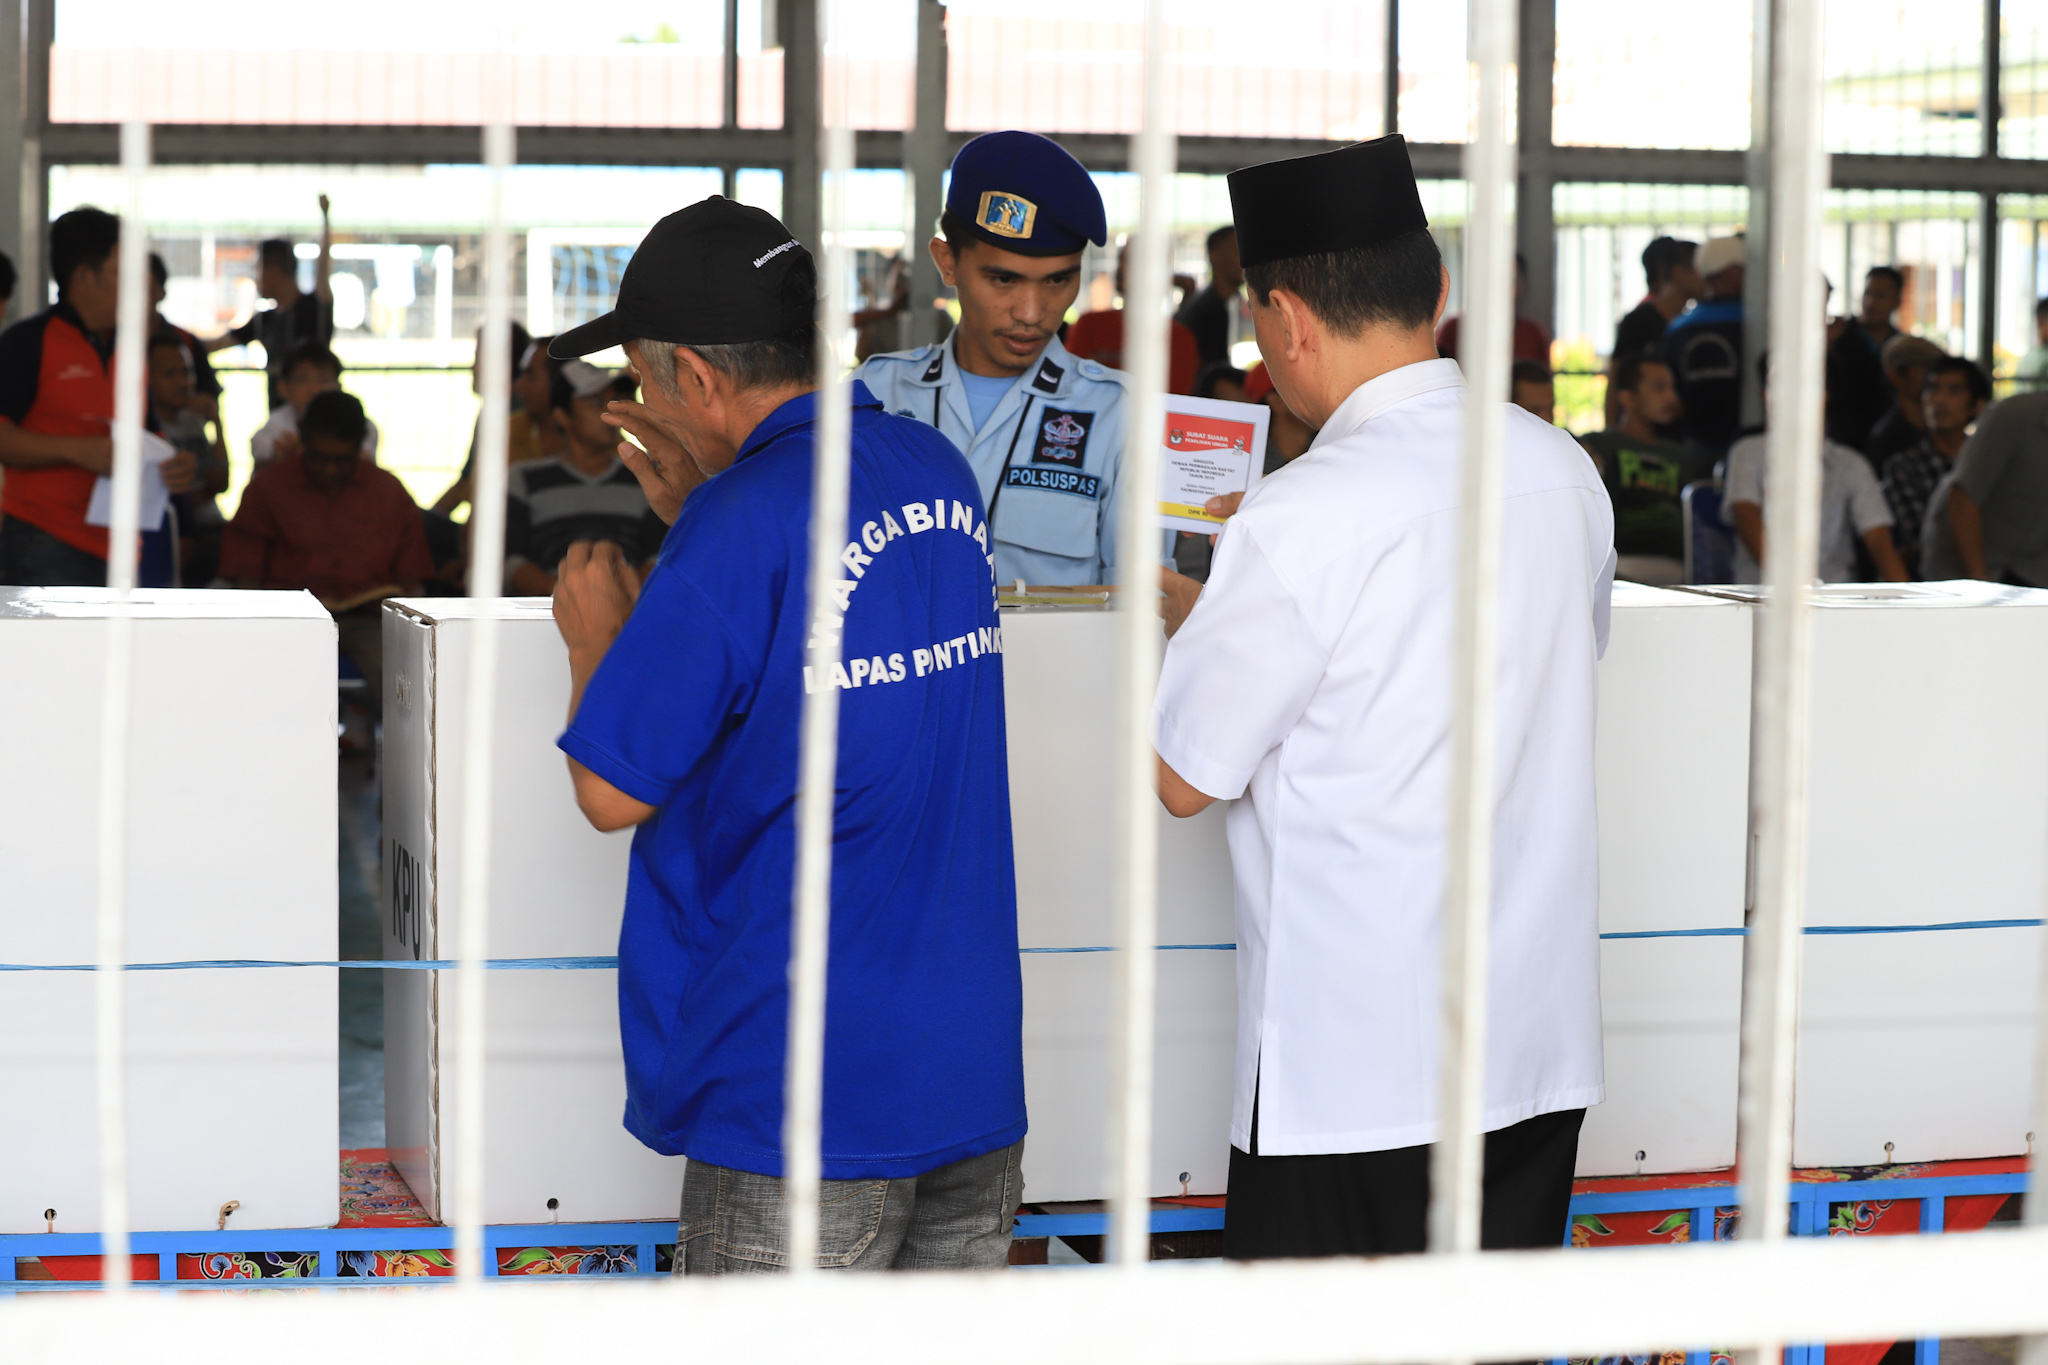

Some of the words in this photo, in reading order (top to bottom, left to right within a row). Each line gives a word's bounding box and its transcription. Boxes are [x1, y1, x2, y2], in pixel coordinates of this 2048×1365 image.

[1186, 431, 1206, 440] SURAT
[1207, 434, 1228, 442] SUARA
[1009, 469, 1096, 495] POLSUSPAS
[807, 510, 904, 648] WARGA
[803, 653, 906, 694] LAPAS
[392, 838, 421, 961] KPU
